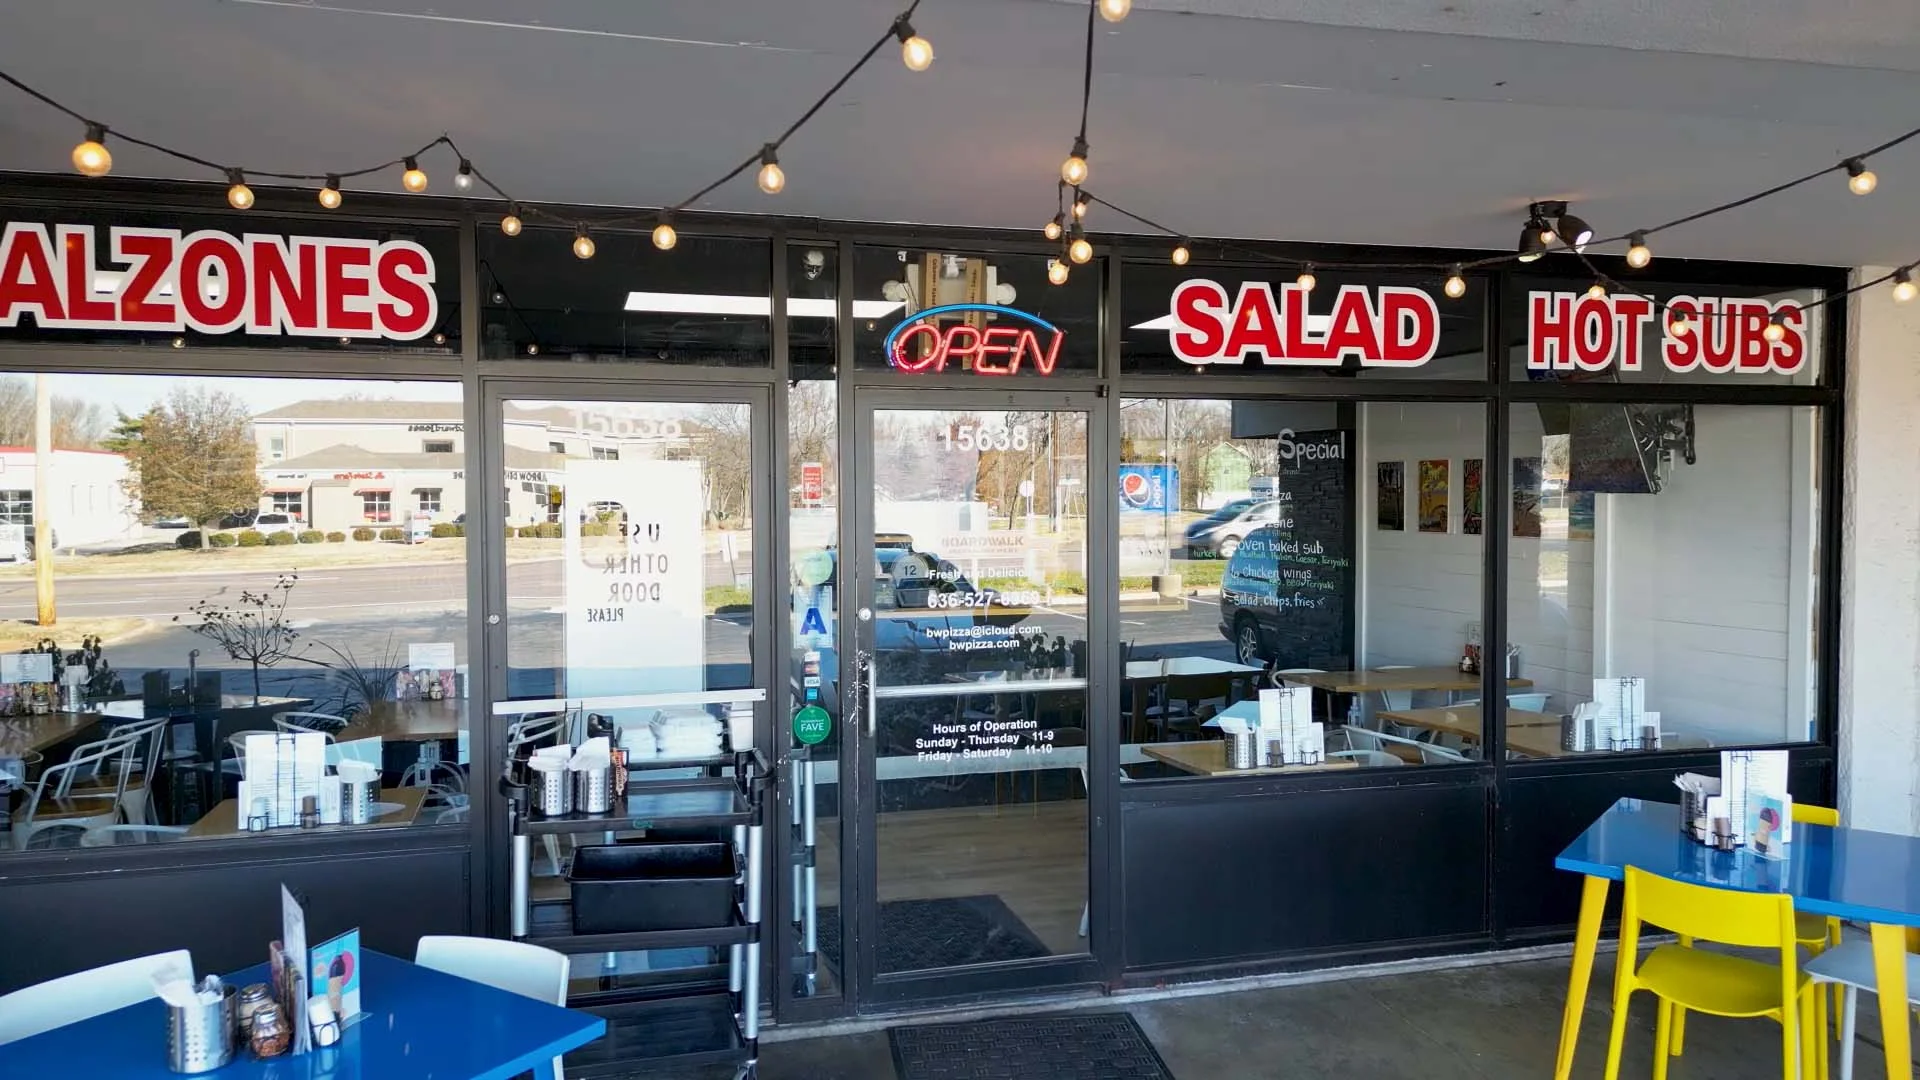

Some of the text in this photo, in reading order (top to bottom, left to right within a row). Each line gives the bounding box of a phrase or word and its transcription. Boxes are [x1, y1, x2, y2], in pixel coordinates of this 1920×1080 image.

[0, 222, 438, 341] ALZONES
[1169, 279, 1440, 368] SALAD
[1527, 290, 1807, 375] HOT SUBS
[894, 322, 1064, 376] OPEN
[941, 424, 1029, 452] 15638
[1278, 428, 1345, 468] Special
[1238, 539, 1265, 551] oven
[1269, 540, 1299, 554] baked
[903, 565, 917, 577] 12
[929, 567, 961, 581] Fresh
[1283, 568, 1312, 585] wings
[800, 607, 828, 635] A
[926, 624, 1042, 639] bwpizza@icloud.com
[949, 638, 1020, 652] bwpizza.com
[801, 722, 825, 732] FAVE
[932, 719, 1038, 735] Hours of Operation
[915, 737, 958, 750] Sunday
[968, 733, 1020, 747] Thursday
[1032, 731, 1055, 742] 11-9
[917, 750, 953, 763] Friday
[963, 747, 1012, 759] Saturday
[1024, 744, 1053, 756] 11-10
